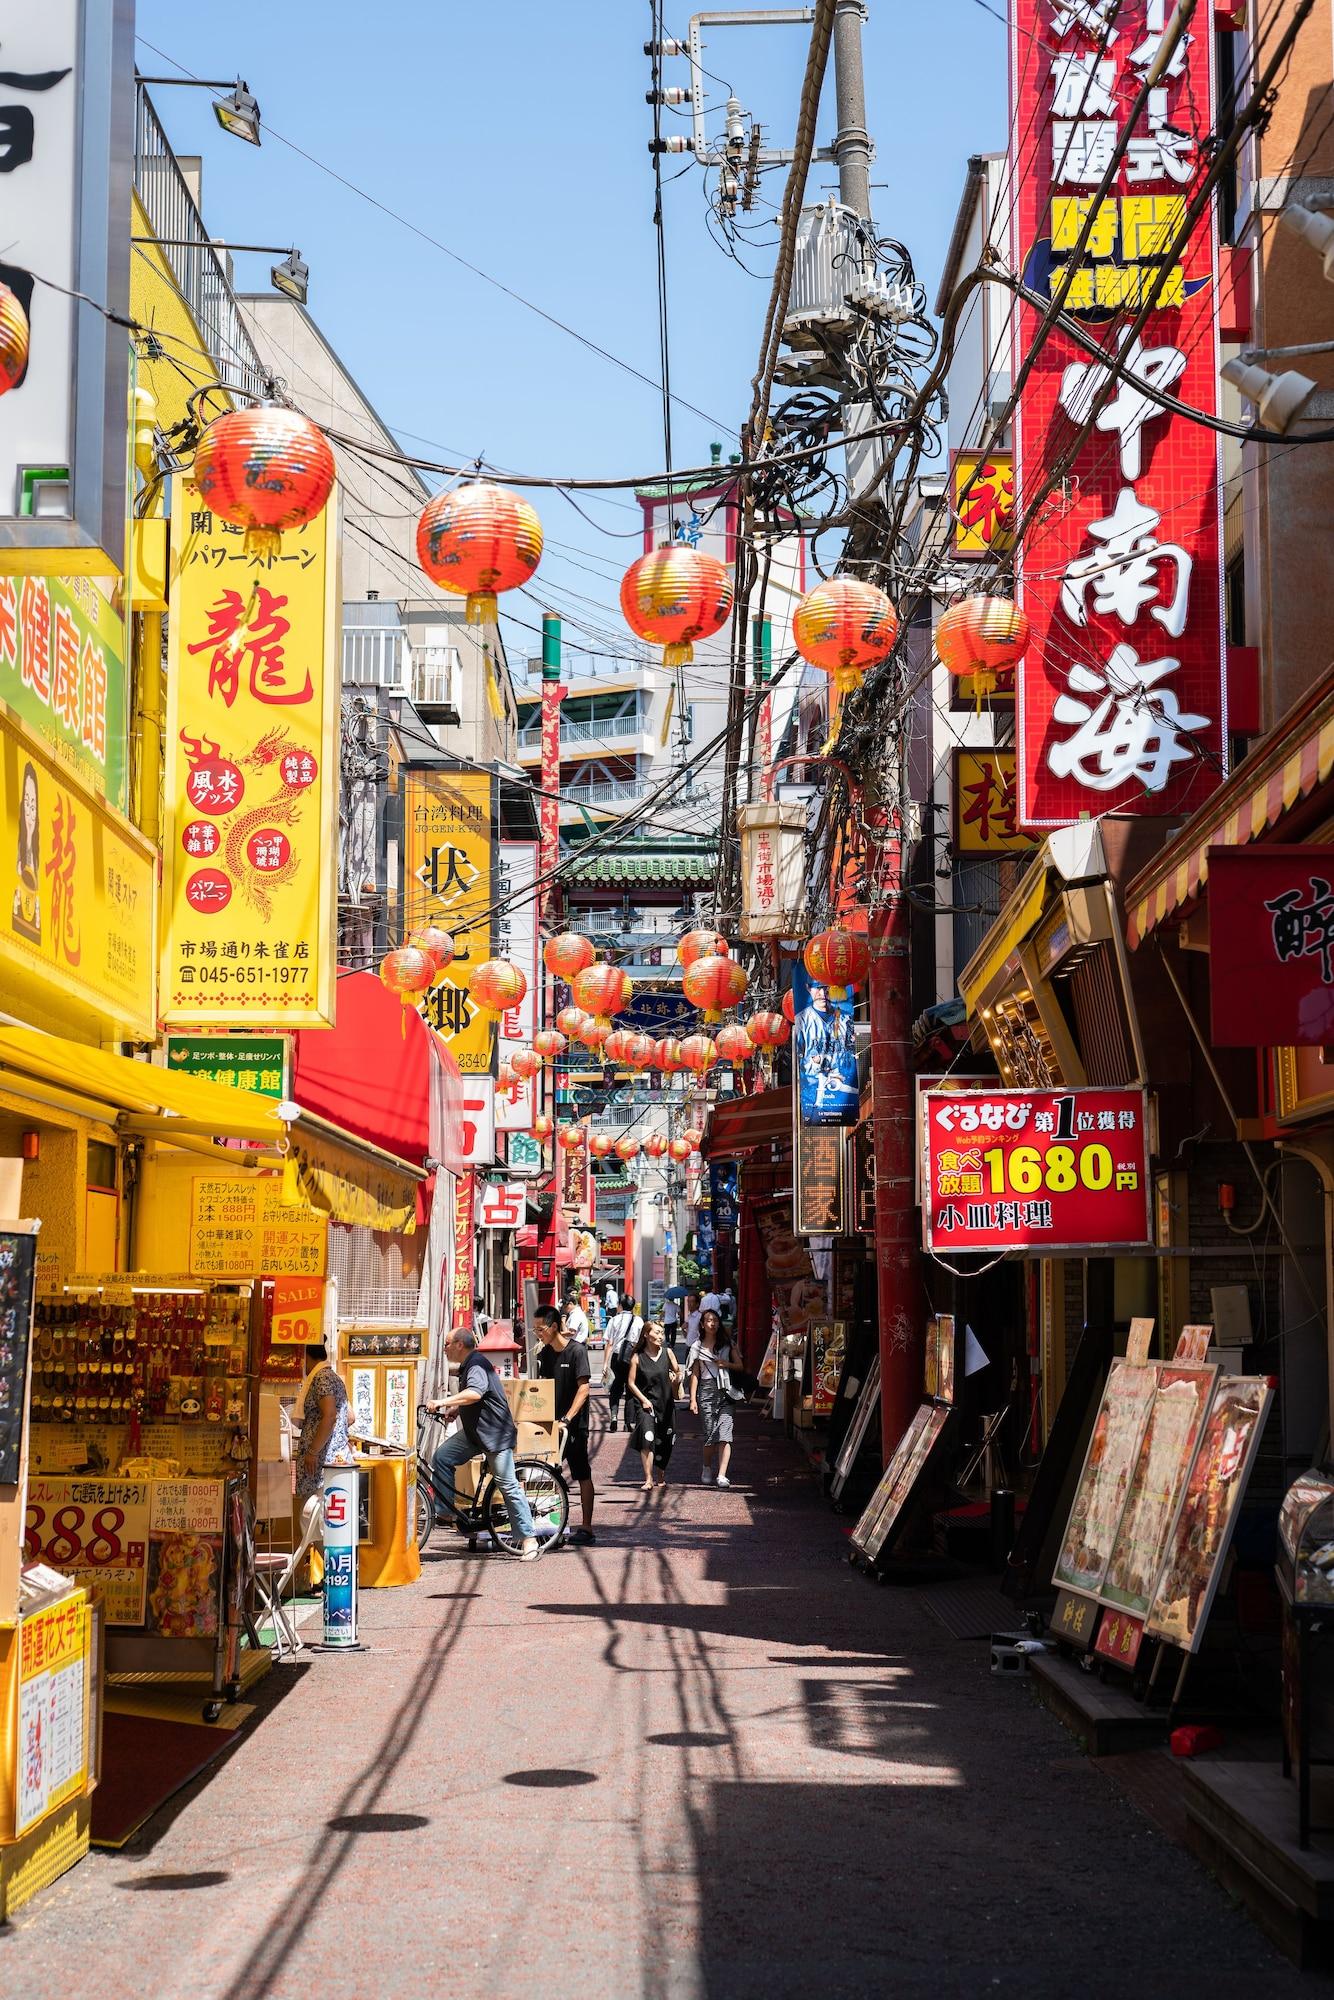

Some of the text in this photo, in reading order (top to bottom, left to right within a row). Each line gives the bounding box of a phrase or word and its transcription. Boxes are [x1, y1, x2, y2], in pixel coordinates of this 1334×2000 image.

[190, 544, 317, 571] パワーストーン
[1047, 324, 1212, 793] 中南海
[188, 586, 315, 710] 龍
[192, 770, 239, 791] 風水
[193, 789, 237, 806] グッズ
[413, 805, 484, 822] 台湾料理
[187, 825, 215, 838] 中華
[186, 838, 216, 853] 雑貨
[757, 831, 775, 910] 中華街市場通り
[190, 881, 228, 892] パワー
[190, 891, 228, 902] ストーン
[180, 941, 310, 959] 市場通り朱雀店
[199, 966, 309, 984] 045-651-1977
[935, 1103, 1033, 1132] ぐるなび
[938, 1149, 983, 1172] 食べ
[984, 1143, 1114, 1194] 1680
[938, 1173, 984, 1196] 放題
[483, 1185, 524, 1225] 占
[937, 1200, 1053, 1232] 小皿料理
[264, 1231, 320, 1245] 開運ストア
[278, 1288, 318, 1304] SALE
[277, 1319, 309, 1341] 50
[326, 1494, 346, 1521] 占
